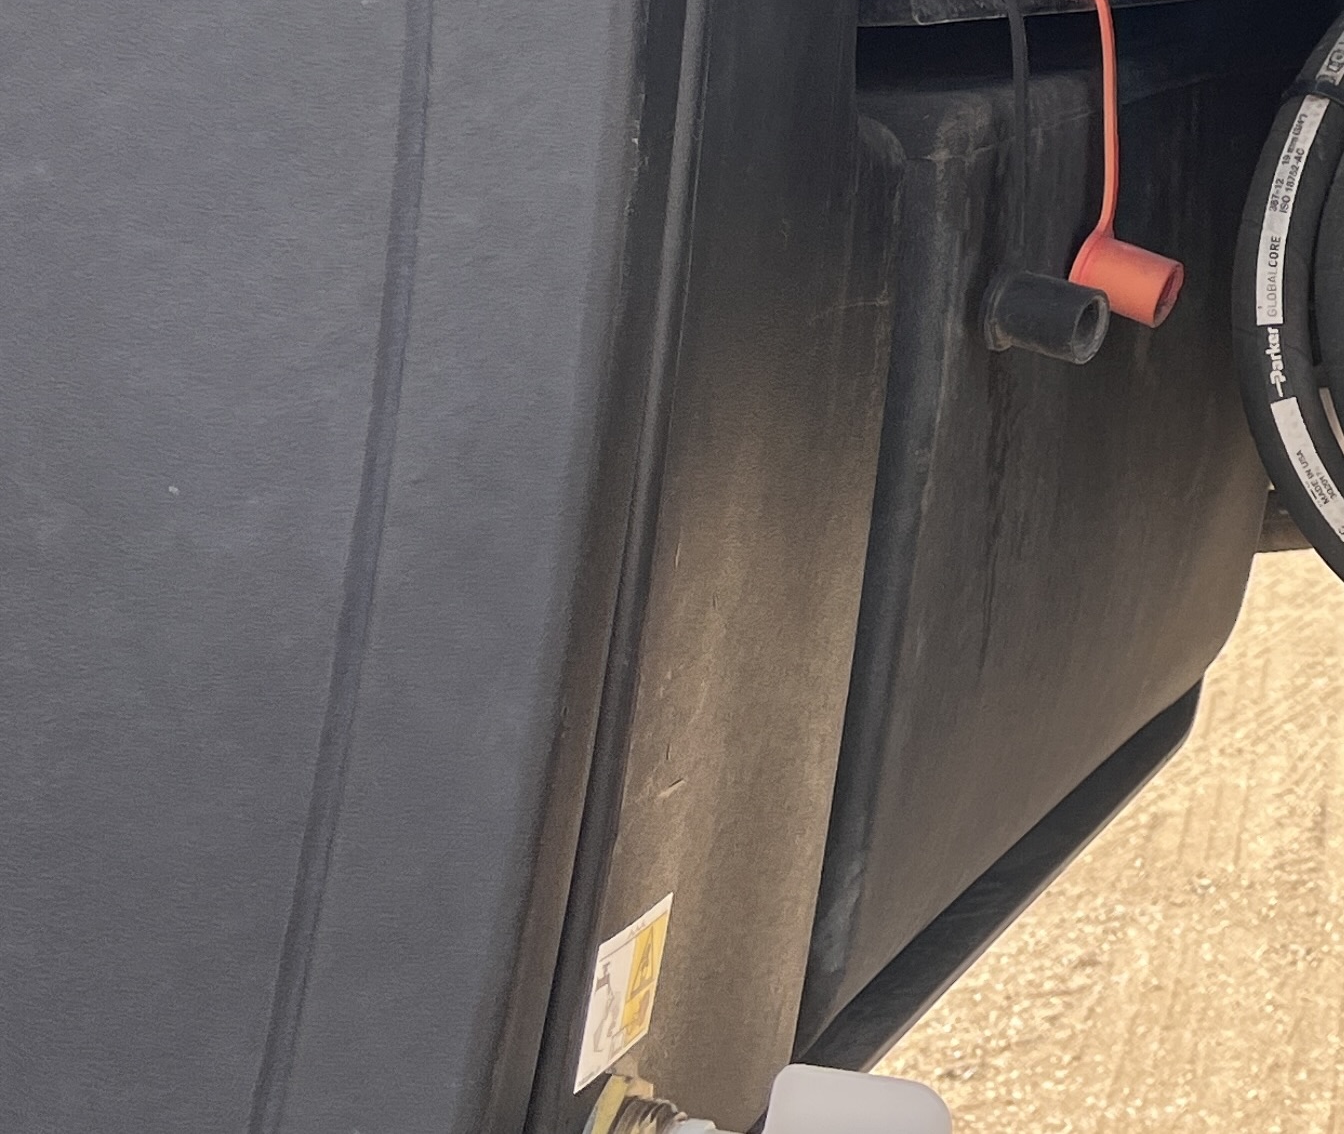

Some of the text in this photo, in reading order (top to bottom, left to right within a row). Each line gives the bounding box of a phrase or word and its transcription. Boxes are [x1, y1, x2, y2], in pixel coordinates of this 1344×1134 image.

[1279, 195, 1291, 213] ISO
[1267, 236, 1282, 316] GLOBALCORE
[1265, 327, 1286, 397] Parker
[1296, 450, 1309, 469] USA
[1305, 468, 1314, 479] IN
[1311, 479, 1330, 505] MADE
